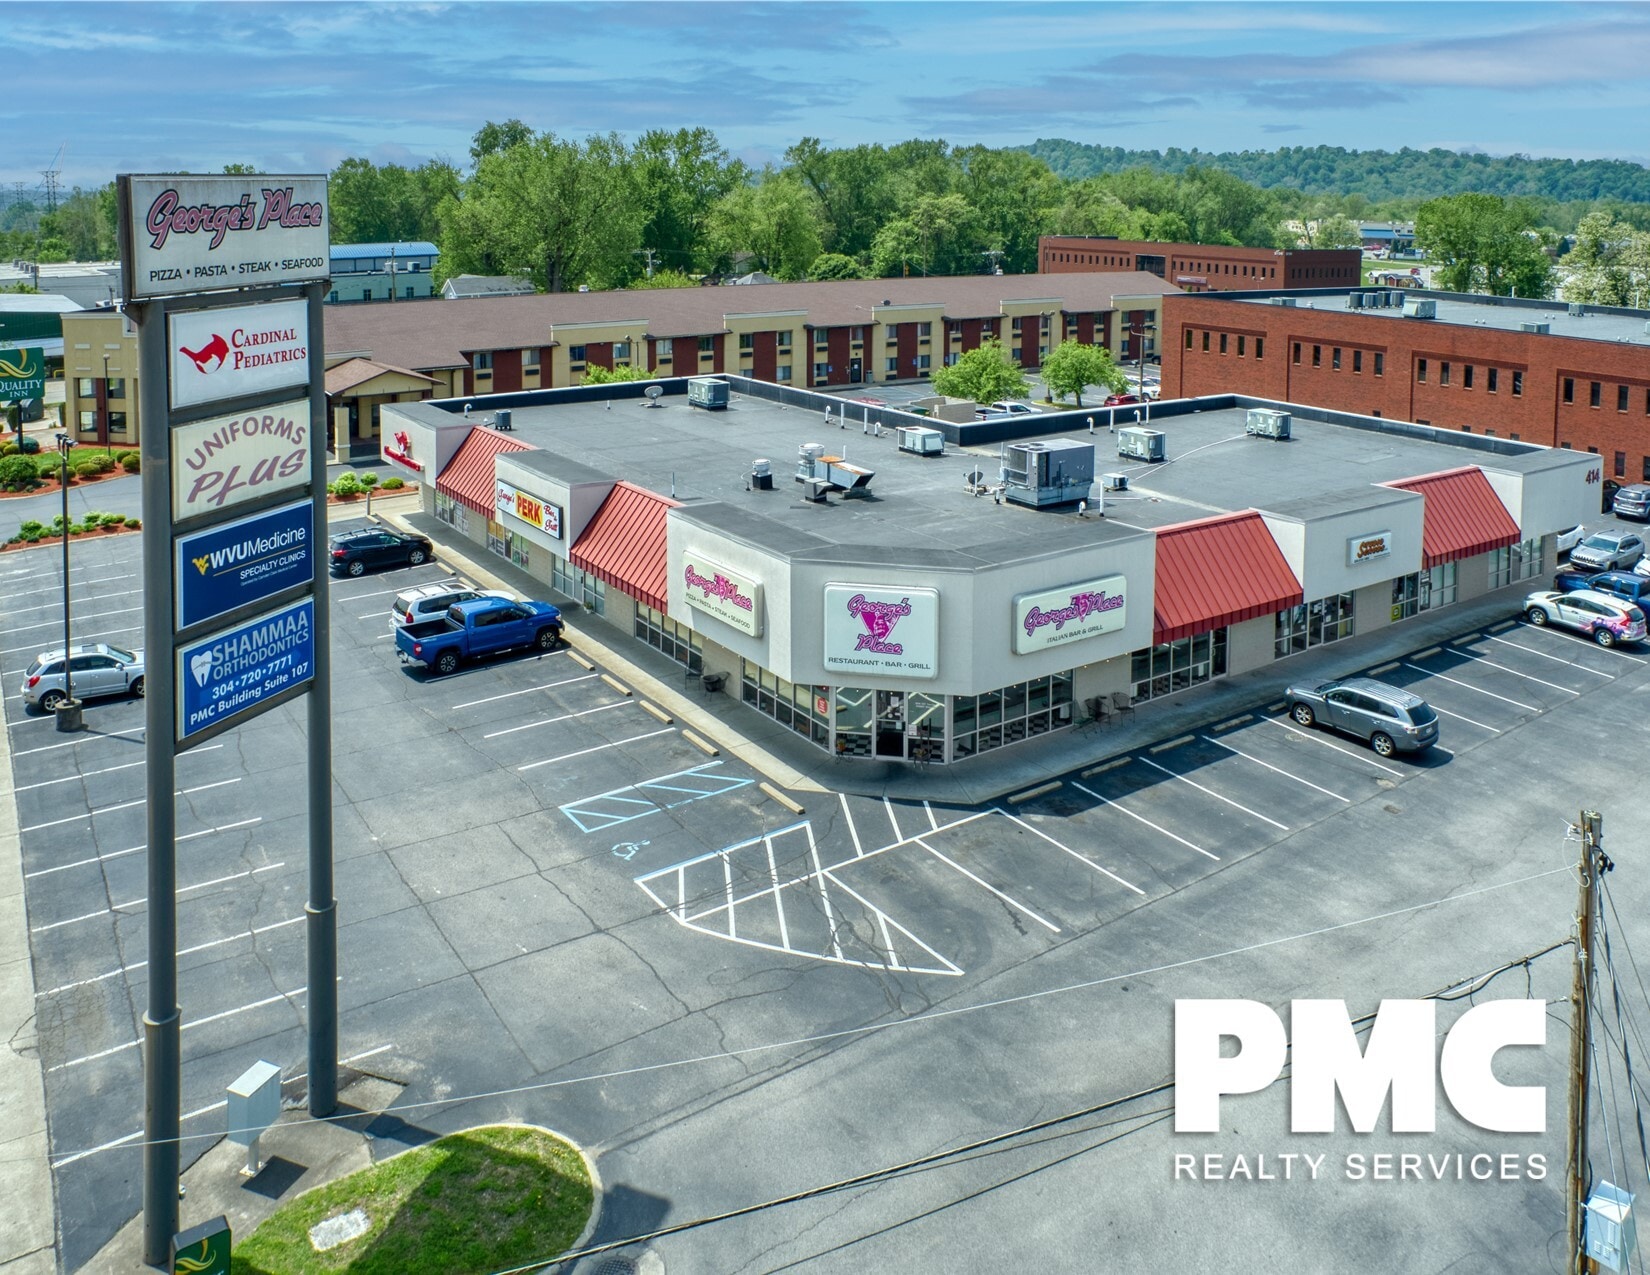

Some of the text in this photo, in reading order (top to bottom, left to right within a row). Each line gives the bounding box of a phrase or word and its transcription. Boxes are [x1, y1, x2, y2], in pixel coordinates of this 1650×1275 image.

[146, 187, 322, 250] George's Place
[150, 257, 324, 282] PIZZA PASTA STEAK SEAFOOD
[232, 328, 297, 348] CARDINAL
[233, 347, 306, 370] PEDIATRICS
[10, 390, 28, 398] INN
[185, 415, 306, 470] UNIFORMS
[517, 494, 541, 525] PERK
[240, 559, 278, 580] SPECIALTY
[278, 550, 306, 566] CLINICS
[725, 581, 753, 612] Place
[847, 594, 912, 621] George's
[1086, 591, 1124, 616] Place
[212, 610, 308, 666] SHAMMAA
[854, 633, 903, 656] Place
[1068, 630, 1081, 638] BAR
[213, 628, 309, 680] ORTHODONTICS
[828, 657, 879, 666] RESTAURANT
[190, 661, 308, 725] PMC Building Suite 107
